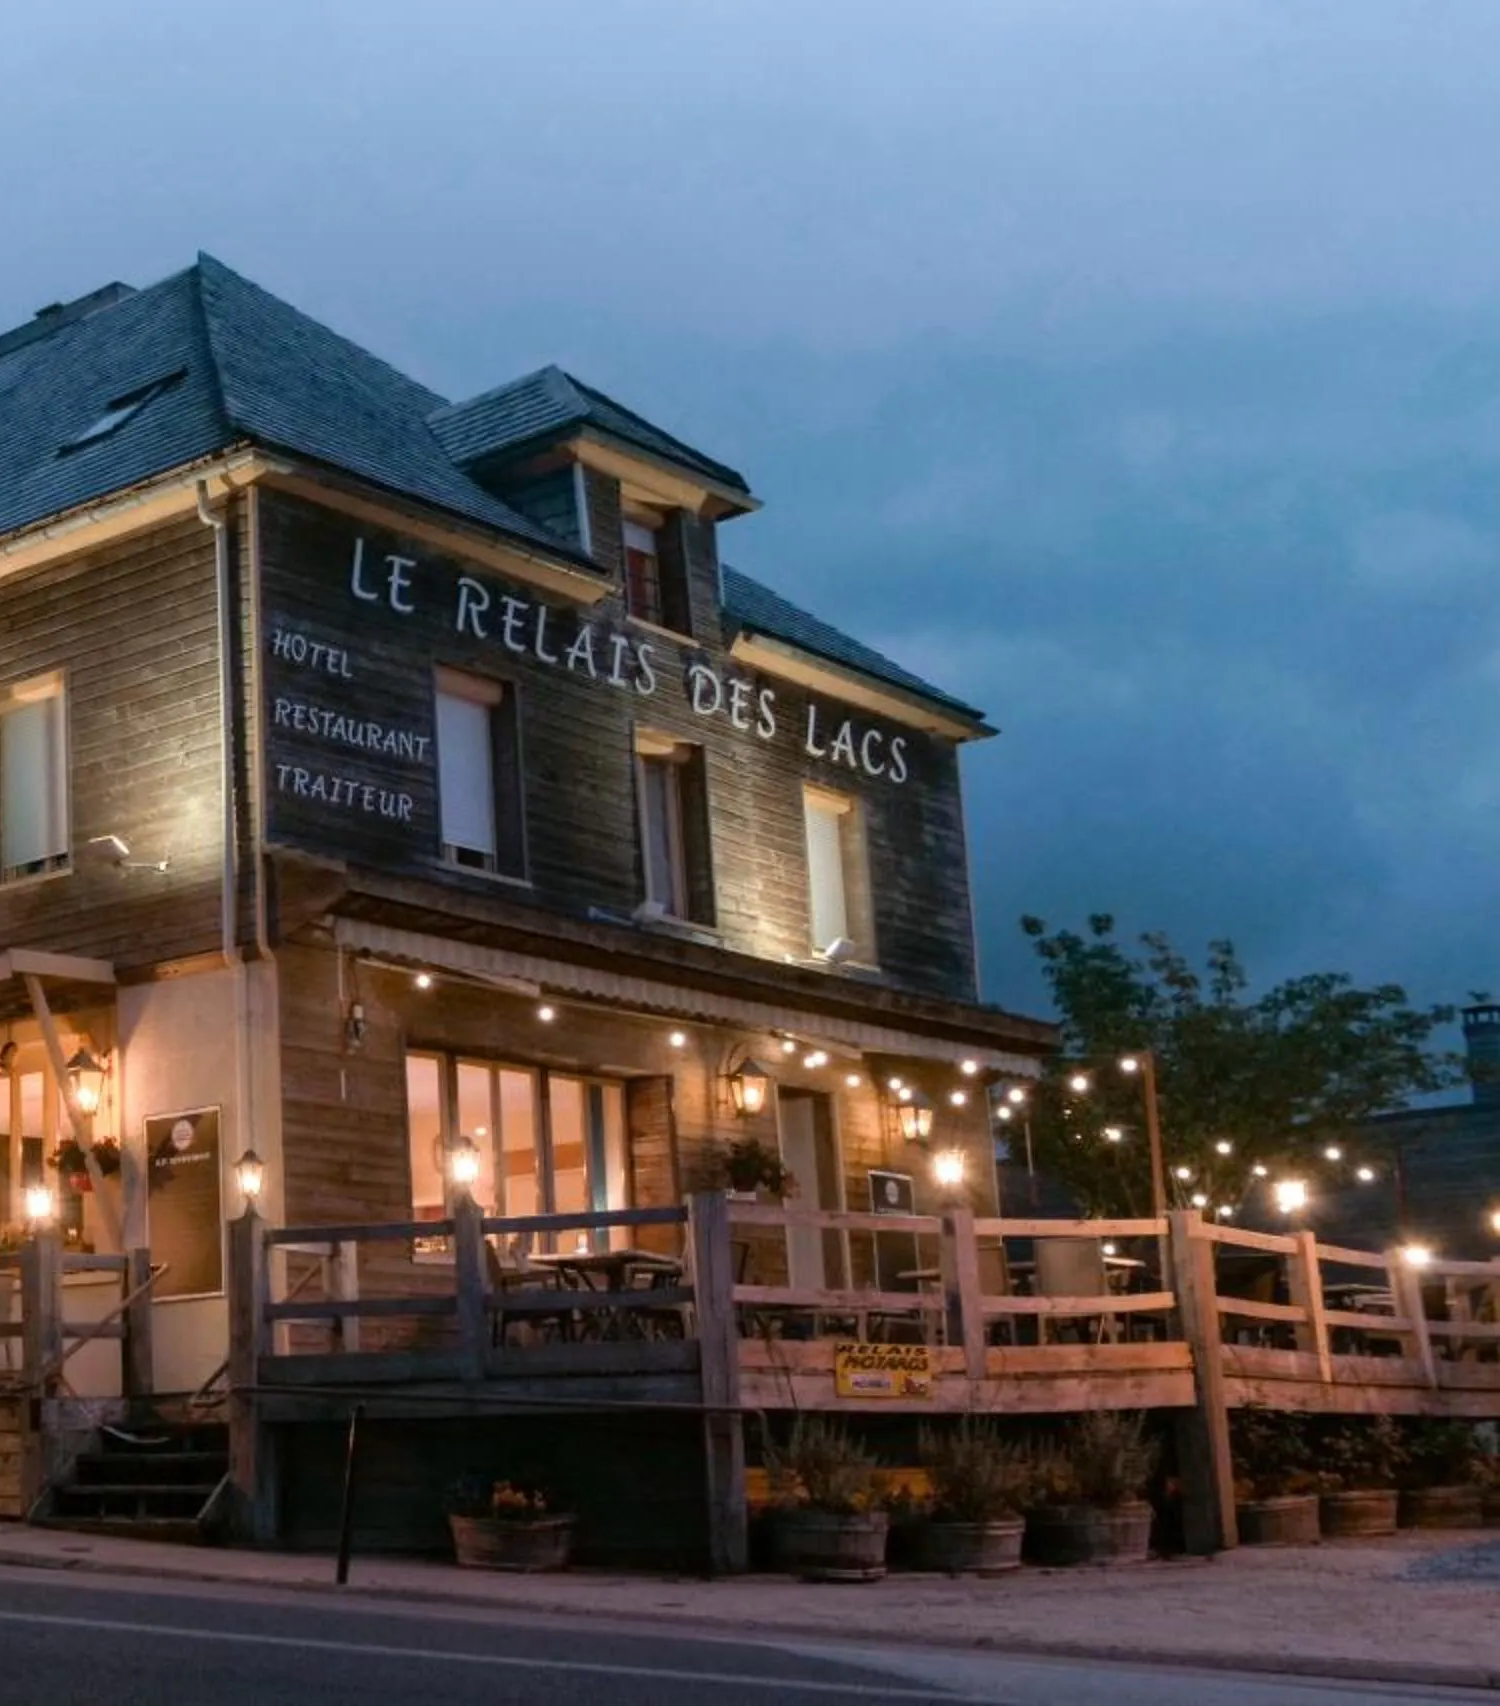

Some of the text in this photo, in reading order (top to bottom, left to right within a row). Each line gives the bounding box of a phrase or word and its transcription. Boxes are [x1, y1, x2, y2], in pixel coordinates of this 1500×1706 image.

[273, 628, 352, 678] HOTEL
[351, 537, 908, 783] LE RELAIS DES LACS
[274, 698, 430, 761] RESTAURANT
[276, 764, 413, 821] TRAITEUR
[837, 1344, 928, 1356] RELAIS
